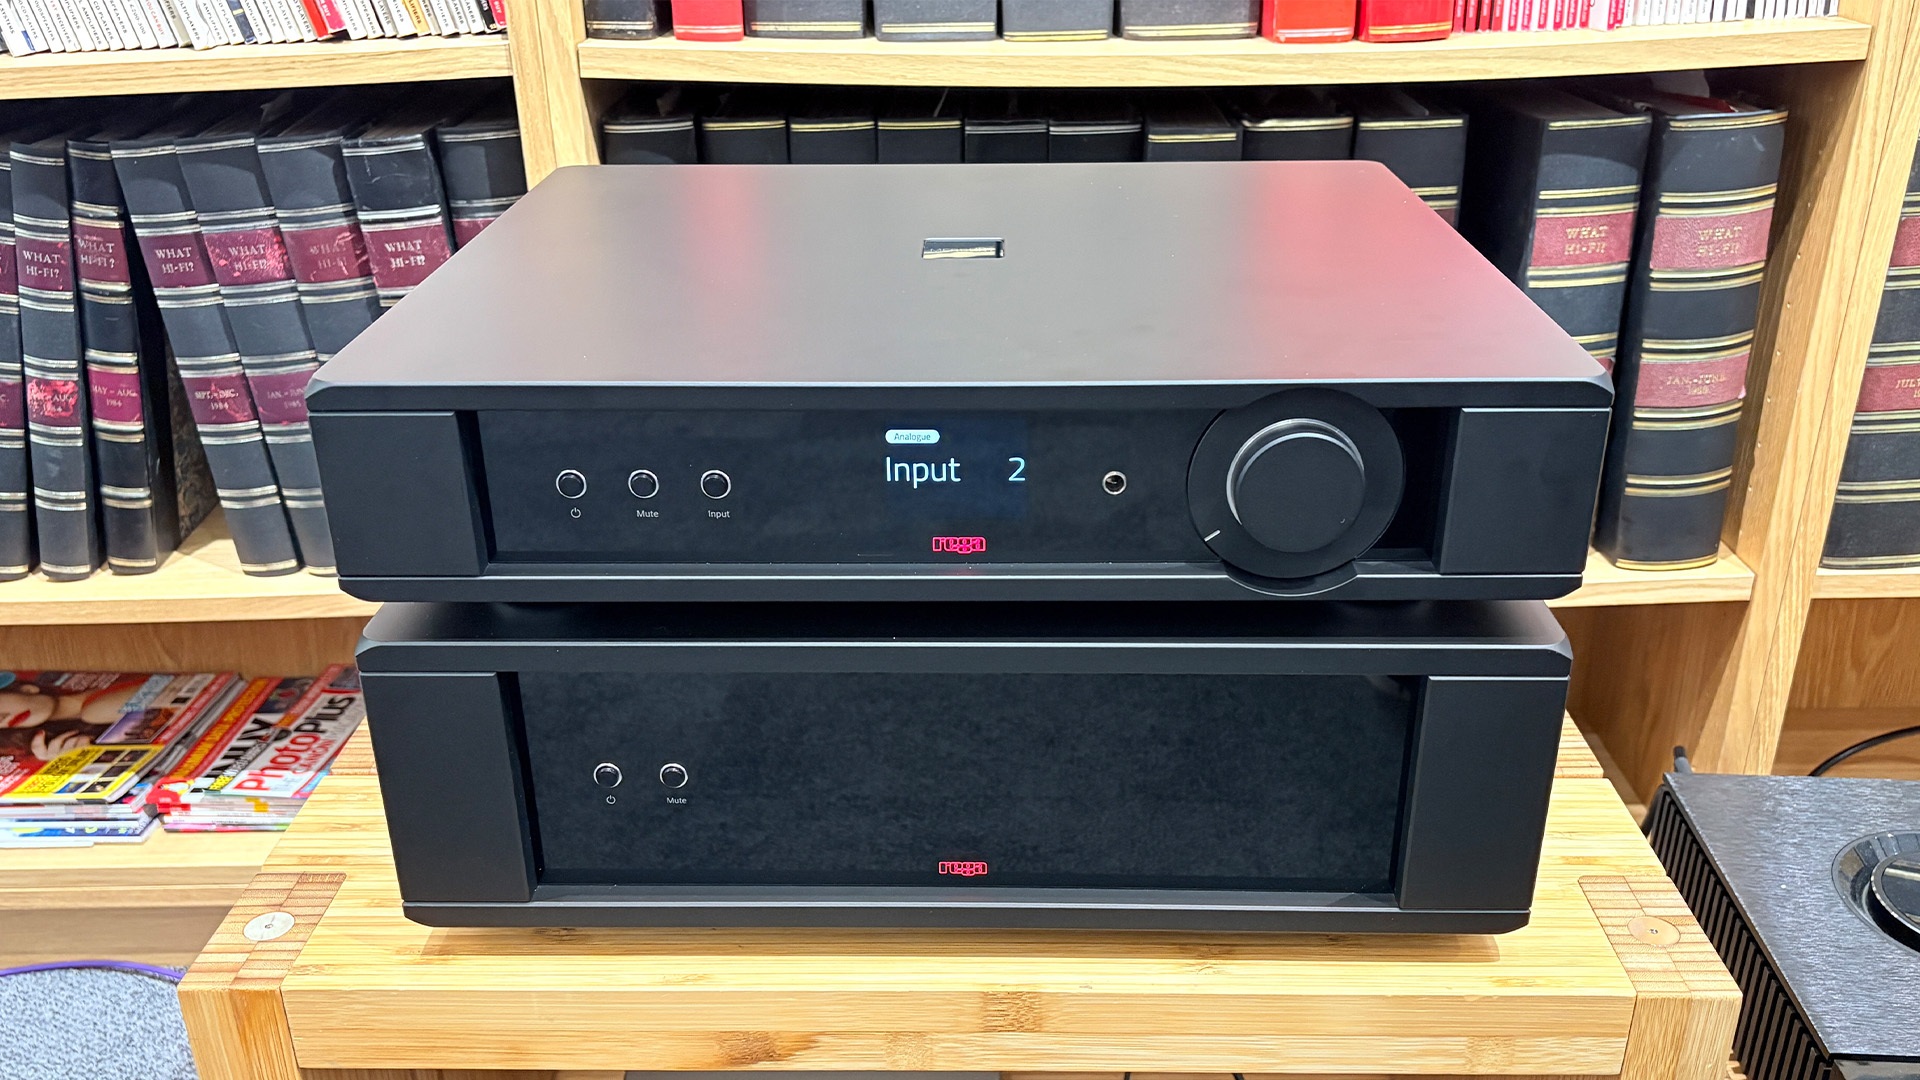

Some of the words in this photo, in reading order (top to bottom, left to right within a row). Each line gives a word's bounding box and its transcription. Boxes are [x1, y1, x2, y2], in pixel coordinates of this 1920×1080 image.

[1564, 226, 1608, 240] WHAT
[1698, 226, 1742, 241] WHAT
[78, 239, 115, 253] WHAT
[155, 247, 192, 259] WHAT
[228, 244, 265, 256] WHAT
[384, 239, 422, 253] WHAT
[22, 250, 61, 264] WHAT
[390, 254, 426, 269] HI-FI?
[26, 265, 60, 278] HI-FI?
[162, 262, 194, 273] HI-FI?
[894, 433, 931, 442] Analogue
[886, 456, 961, 489] Input
[1008, 457, 1026, 482] 2
[636, 509, 659, 518] Mute
[708, 509, 731, 519] Input
[932, 536, 987, 554] rega
[938, 861, 988, 877] rega
